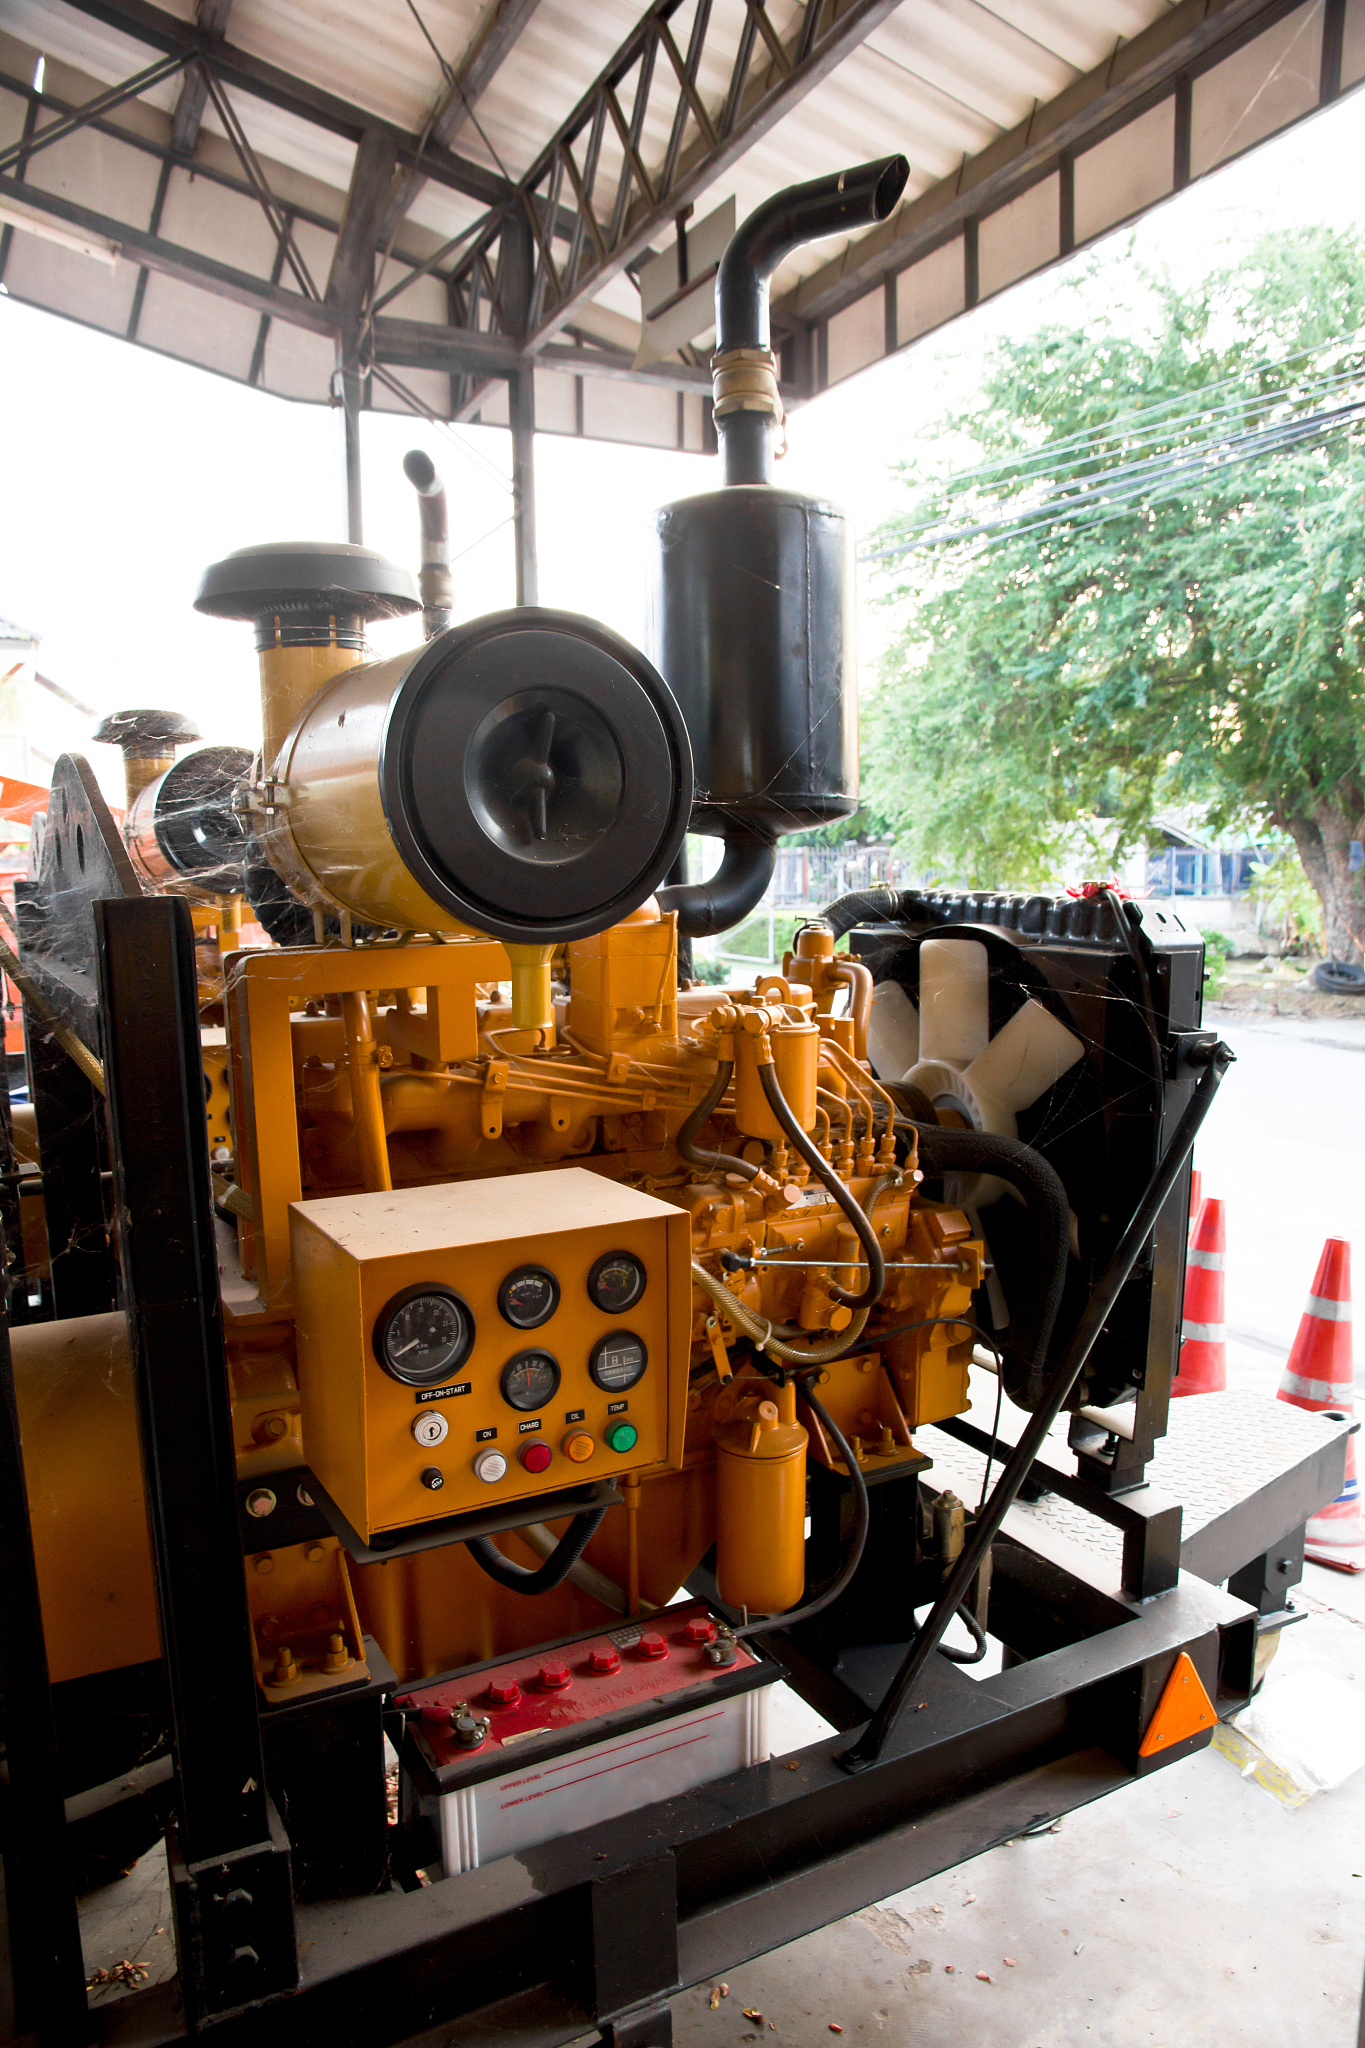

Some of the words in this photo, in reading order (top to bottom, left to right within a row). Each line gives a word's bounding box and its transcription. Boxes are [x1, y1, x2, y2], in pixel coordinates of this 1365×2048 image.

[421, 1386, 465, 1400] OFF-ON-START
[610, 1404, 624, 1412] TEMP
[520, 1422, 539, 1431] CHARG
[500, 1780, 521, 1791] UPPER
[523, 1774, 541, 1784] LEVEL
[501, 1798, 524, 1809] LOWER
[525, 1792, 544, 1801] LEVEL
